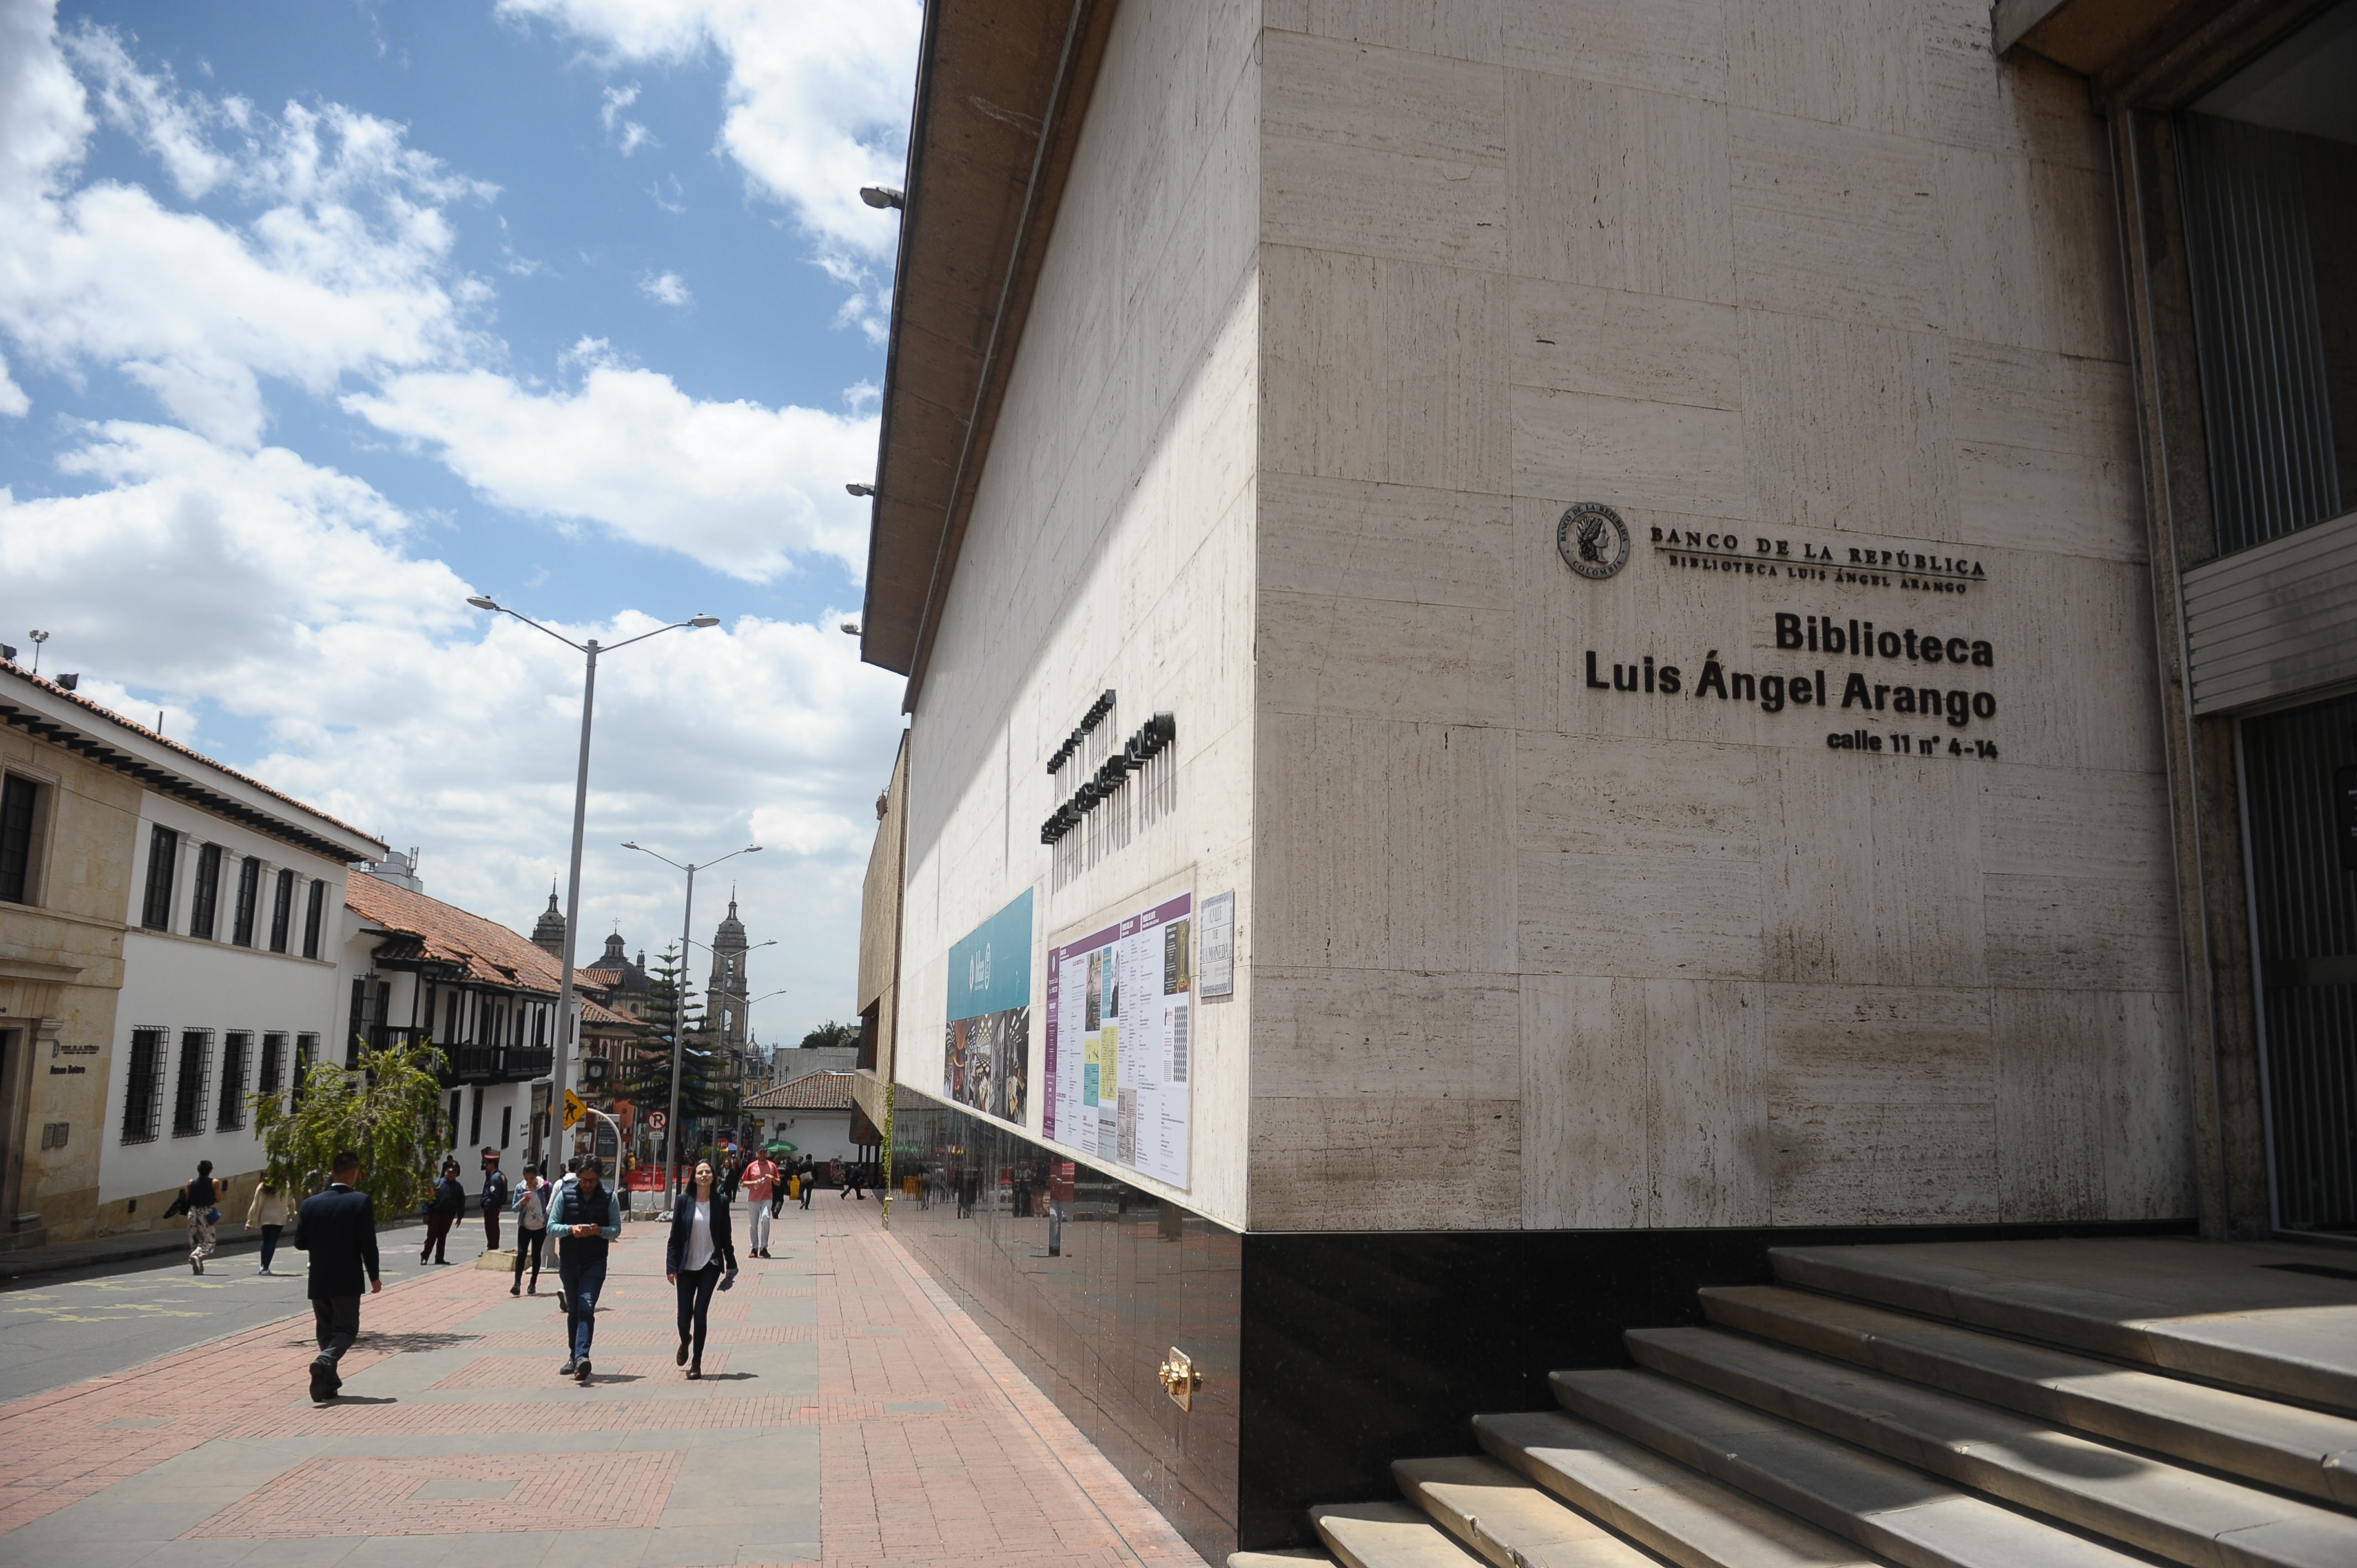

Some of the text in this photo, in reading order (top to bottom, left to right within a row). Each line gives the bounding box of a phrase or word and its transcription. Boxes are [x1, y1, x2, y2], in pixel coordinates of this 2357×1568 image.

[1561, 515, 1572, 542] BANCO
[1572, 506, 1583, 515] DE
[1573, 560, 1623, 576] COLOMBIA
[1650, 527, 1985, 576] BANCO DE LA REPÚBLICA
[1669, 555, 1967, 594] BIBLIOTECA LUIS ÁNGEL ARANGO
[1775, 612, 1993, 669] Biblioteca
[1586, 649, 1996, 728] Luis Ángel Arango
[1826, 729, 1882, 751] calle
[1890, 734, 1911, 754] 11
[1948, 737, 1999, 759] 4-14
[1210, 906, 1222, 922] CALLE
[1213, 929, 1218, 940] DE
[653, 1114, 663, 1126] P
